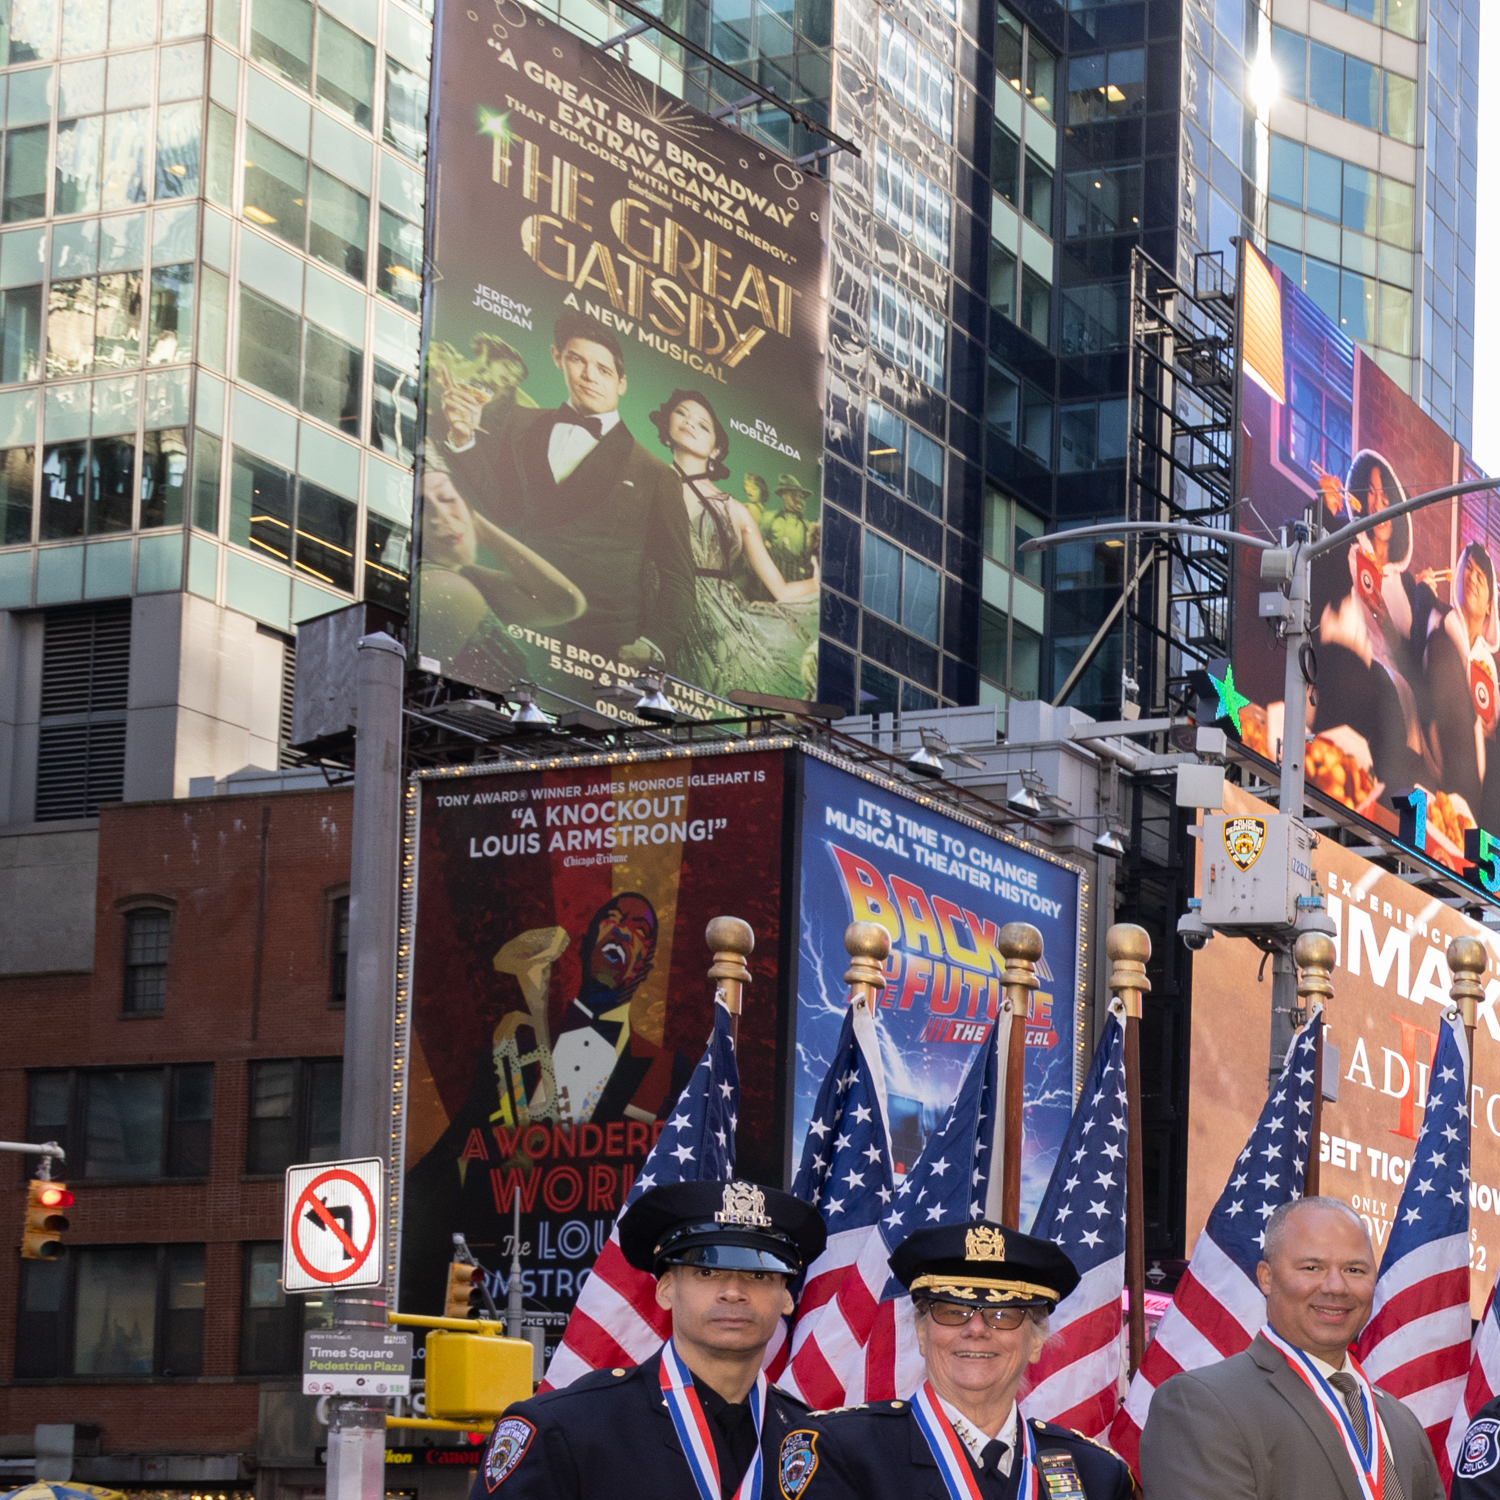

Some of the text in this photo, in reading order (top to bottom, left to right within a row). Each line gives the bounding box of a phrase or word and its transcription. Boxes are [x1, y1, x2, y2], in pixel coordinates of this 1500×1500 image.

[505, 95, 546, 125] THAT
[550, 119, 629, 173] EXPLODES
[631, 165, 669, 196] WITH
[672, 184, 701, 214] LIFE
[704, 208, 733, 232] AND
[558, 100, 750, 227] EXTRAVAGANZA
[617, 111, 659, 151] BIG
[667, 136, 795, 229] BROADWAY
[491, 129, 801, 338] THE GREAT
[474, 283, 532, 318] JEREMY
[520, 214, 766, 369] GATSBY
[472, 300, 532, 332] JORDAN
[563, 292, 729, 385] A NEW MUSICAL
[729, 418, 801, 460] NOBLEZADA
[755, 418, 777, 439] EVA
[524, 632, 562, 655] THE
[599, 672, 612, 687] &
[436, 770, 766, 808] TONY WINNER JAMES MONROE IGLEHART IS
[546, 795, 685, 827] KNOCKOUT
[1233, 819, 1257, 827] POLICE
[469, 832, 541, 859] LOUIS
[1225, 824, 1264, 836] DEPARTMENT
[563, 852, 628, 869] Chicago Tribune
[825, 806, 1063, 920] MUSICAL THEATER HISTORY
[896, 814, 938, 849] TIME
[941, 834, 966, 859] TO
[969, 846, 1038, 891] CHANGE
[1226, 840, 1235, 854] CITY
[830, 842, 1010, 975] BACK
[953, 1023, 986, 1042] THE
[461, 1128, 489, 1162] A
[1352, 1194, 1388, 1217] ONLY
[309, 1346, 394, 1360] Times Square
[309, 1360, 405, 1373] Pedestrian Plaza
[426, 1451, 480, 1465] Canon
[1461, 1457, 1489, 1472] POLICE
